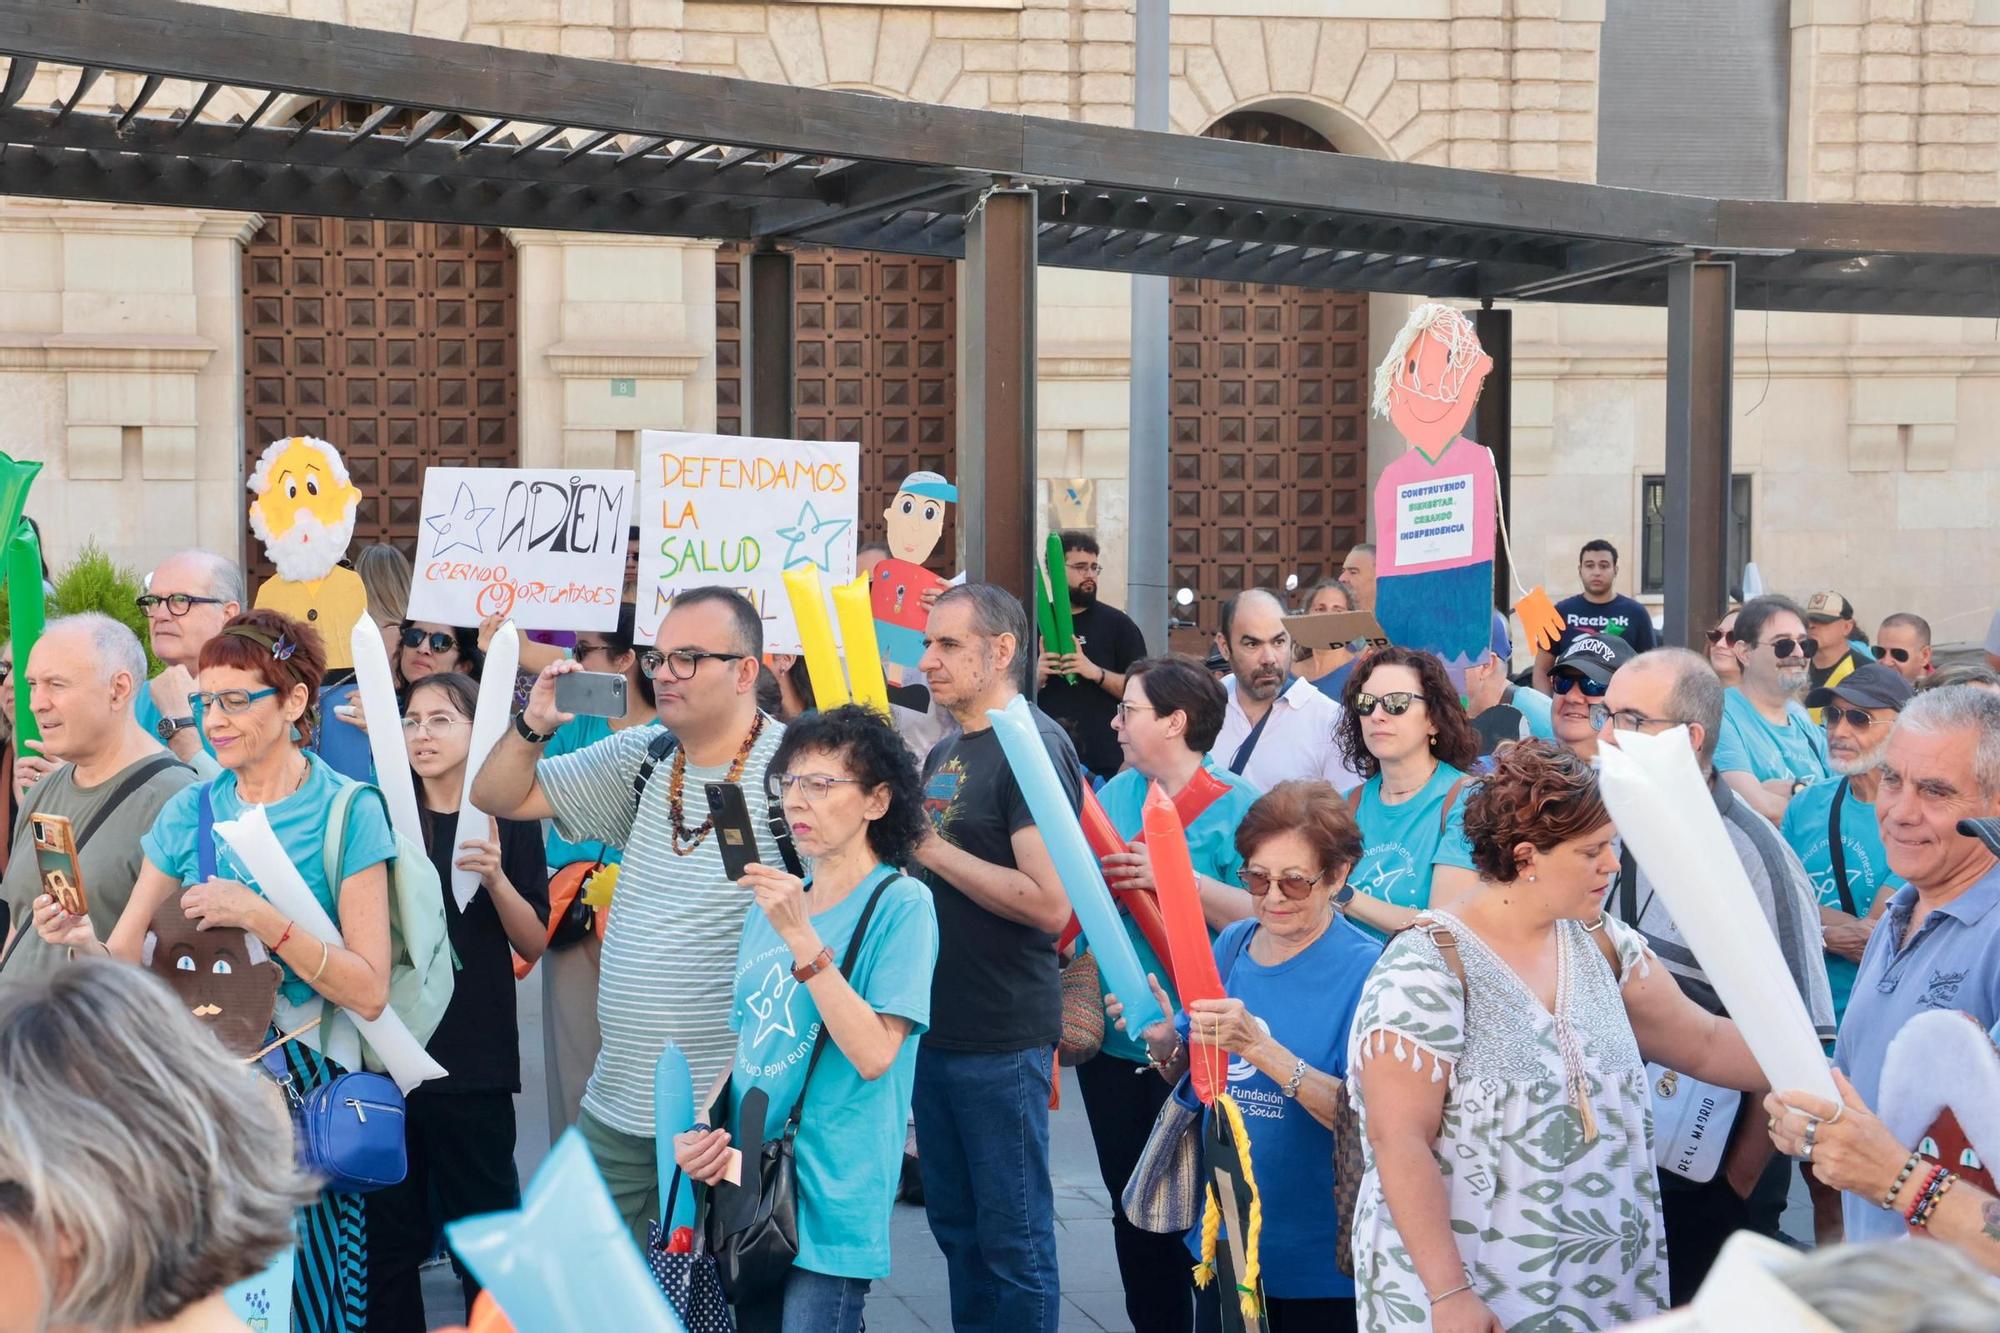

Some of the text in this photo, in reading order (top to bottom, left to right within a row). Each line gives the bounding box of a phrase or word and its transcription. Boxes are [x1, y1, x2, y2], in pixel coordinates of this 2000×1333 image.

[660, 453, 849, 494] DEFENDAMOS
[1401, 480, 1467, 499] CONSTRUYENDO
[662, 499, 700, 529] LA
[1400, 523, 1465, 541] INDEPENDENCIA
[659, 535, 761, 579] SALUD
[425, 560, 509, 583] CREANDO
[654, 584, 778, 620] MAL
[1852, 840, 1876, 888] bienestar
[787, 1041, 812, 1064] una
[764, 1062, 788, 1079] vida
[1231, 1085, 1284, 1105] Fundación
[1248, 1105, 1284, 1119] Social
[1678, 1098, 1714, 1171] REAL MADRID
